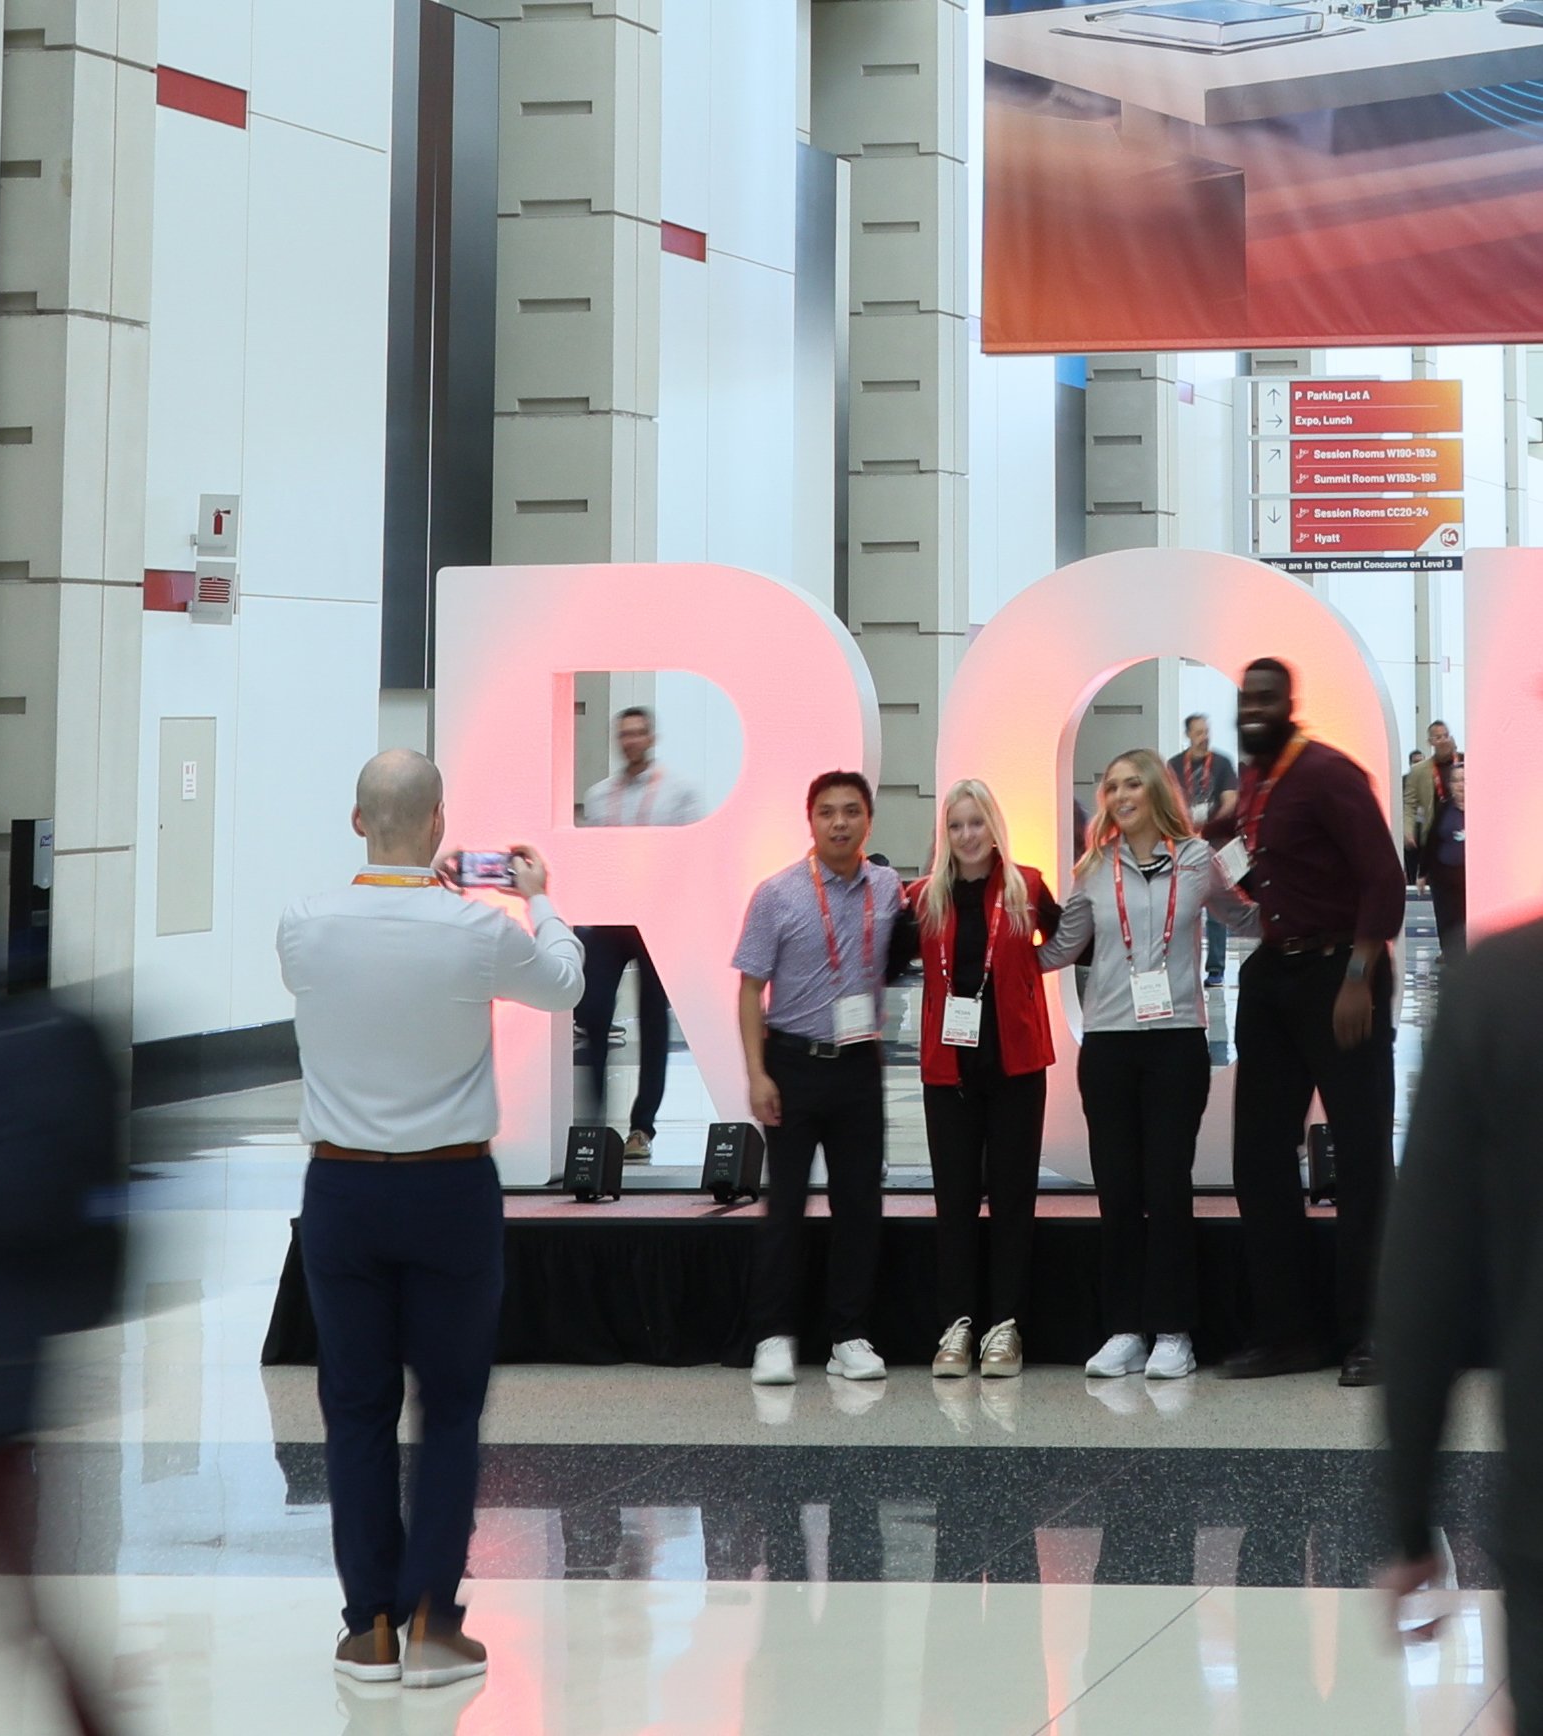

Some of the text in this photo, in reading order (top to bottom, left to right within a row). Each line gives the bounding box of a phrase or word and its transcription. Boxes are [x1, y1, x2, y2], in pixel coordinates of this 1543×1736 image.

[1295, 390, 1371, 402] P Parking Lot A
[1295, 415, 1353, 427] Expo, Lunch
[1313, 449, 1351, 459] Session
[1353, 448, 1385, 459] Rooms
[1313, 473, 1351, 484] Summit
[1352, 473, 1385, 484] Rooms
[1313, 506, 1429, 519] Session Rooms CC20-24
[1314, 533, 1340, 544] Hyatt
[1288, 562, 1302, 570] are
[1304, 560, 1313, 570] in
[1314, 560, 1329, 570] the
[1330, 560, 1362, 570] Central
[1363, 560, 1408, 569] Concourse
[1422, 559, 1445, 568] Level
[1446, 559, 1453, 568] 3
